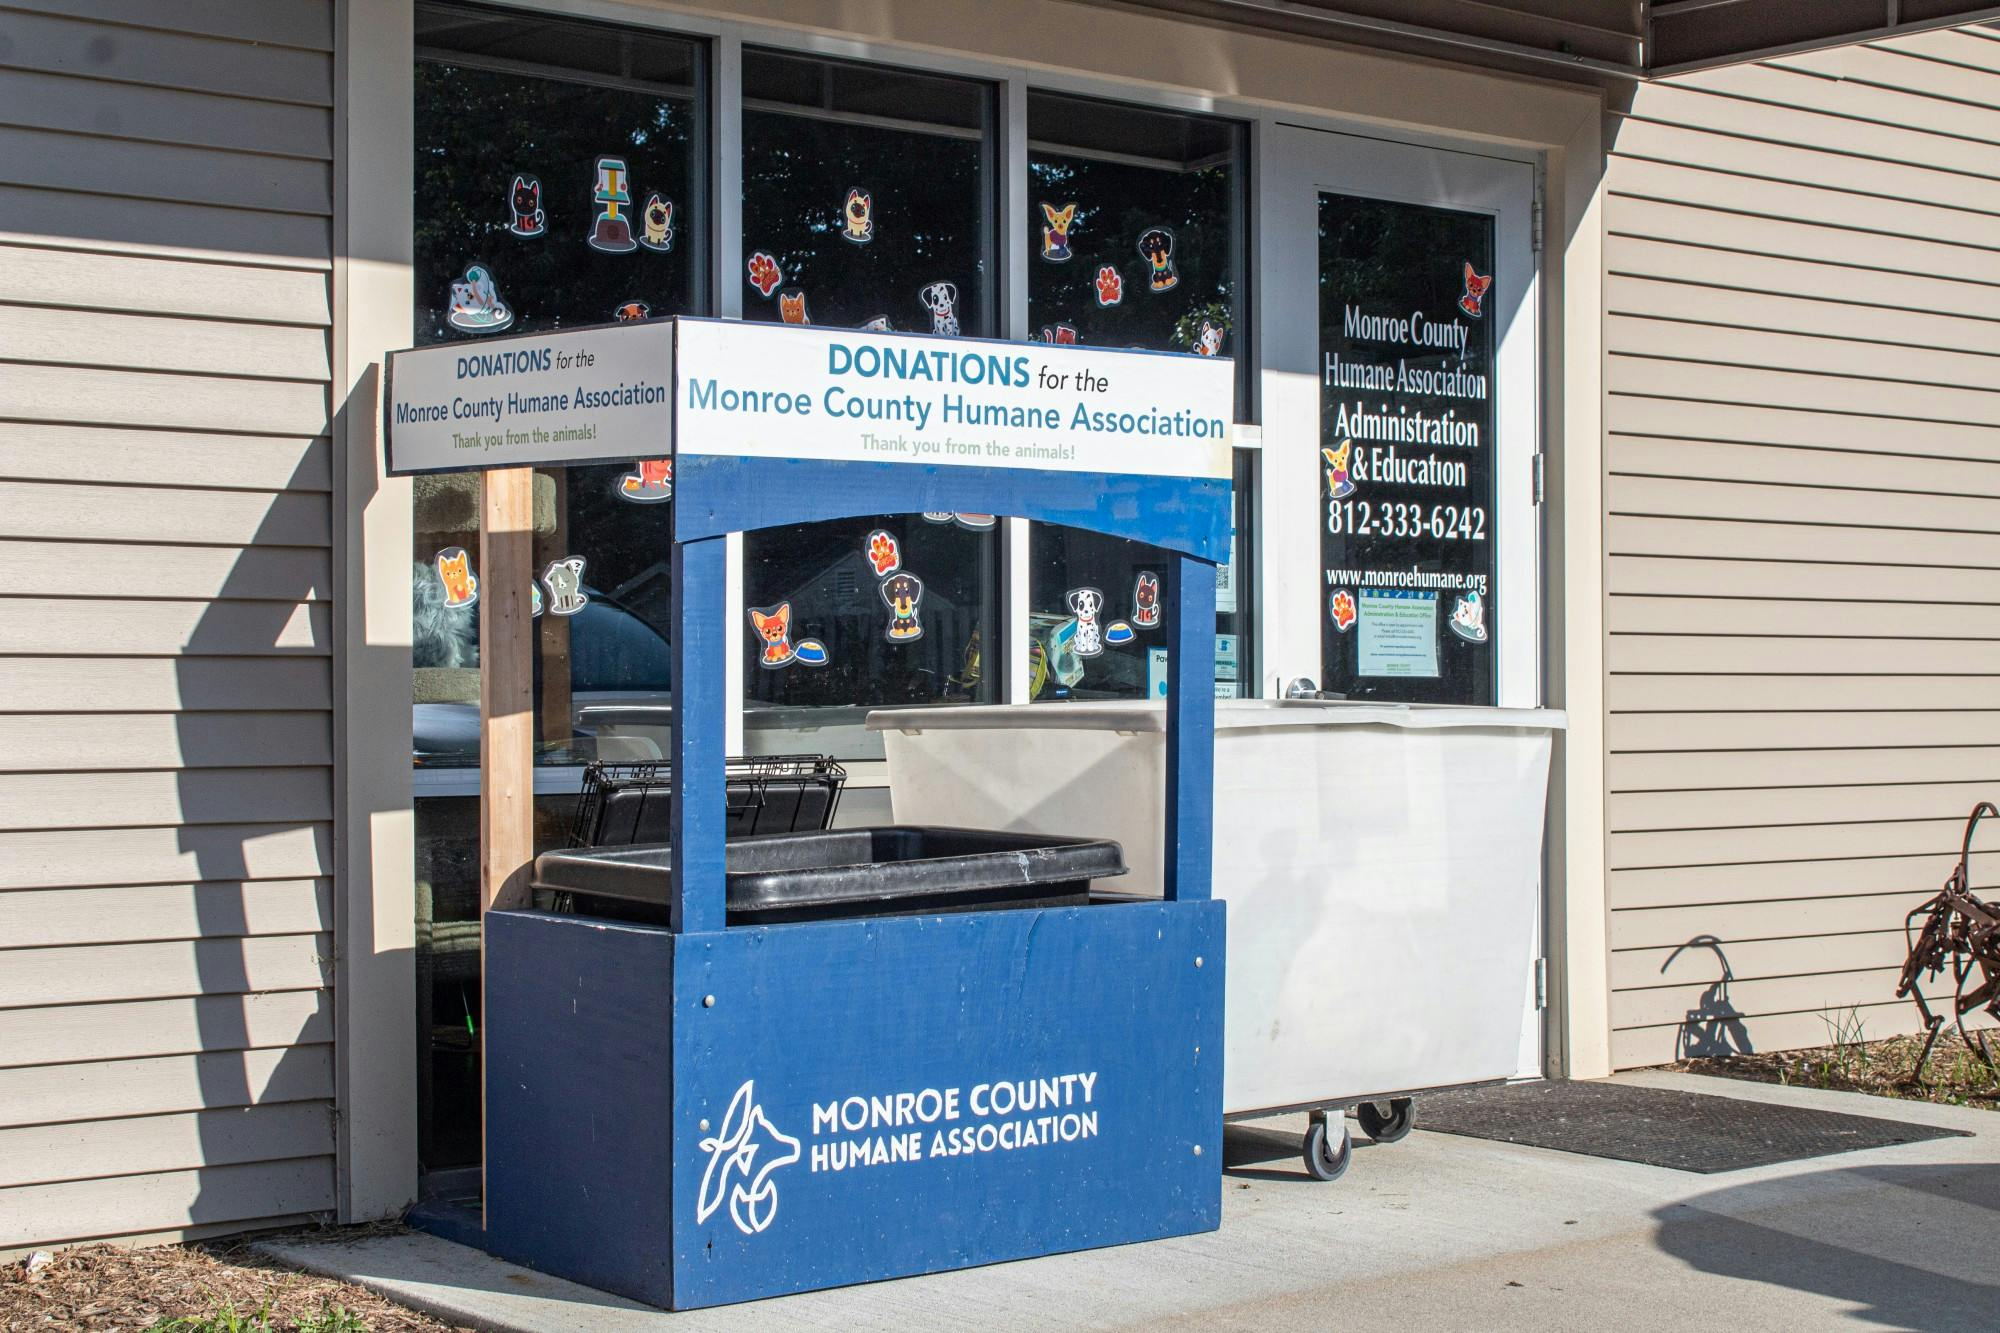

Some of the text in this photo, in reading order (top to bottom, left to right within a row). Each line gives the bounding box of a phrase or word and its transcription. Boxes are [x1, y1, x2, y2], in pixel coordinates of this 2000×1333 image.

[1343, 304, 1468, 360] Monroe County
[457, 348, 595, 379] DONATIONS for the
[828, 343, 1109, 394] DONATIONS for the
[1325, 351, 1486, 400] Humane Association
[396, 381, 665, 424] Monroe County Humane Association
[688, 378, 1225, 440] Monroe County Humane Association
[1335, 400, 1479, 448] Administration
[452, 424, 597, 452] Thank you from the animals!
[860, 433, 1076, 461] Thank you from the animals!
[1352, 446, 1466, 487] & Education
[1328, 500, 1485, 540] 812-333-6242
[1326, 565, 1487, 596] www.monroehumane.org
[812, 1071, 1098, 1135] MONROE COUNTY
[811, 1111, 1098, 1173] HUMANE ASSOCIATION
